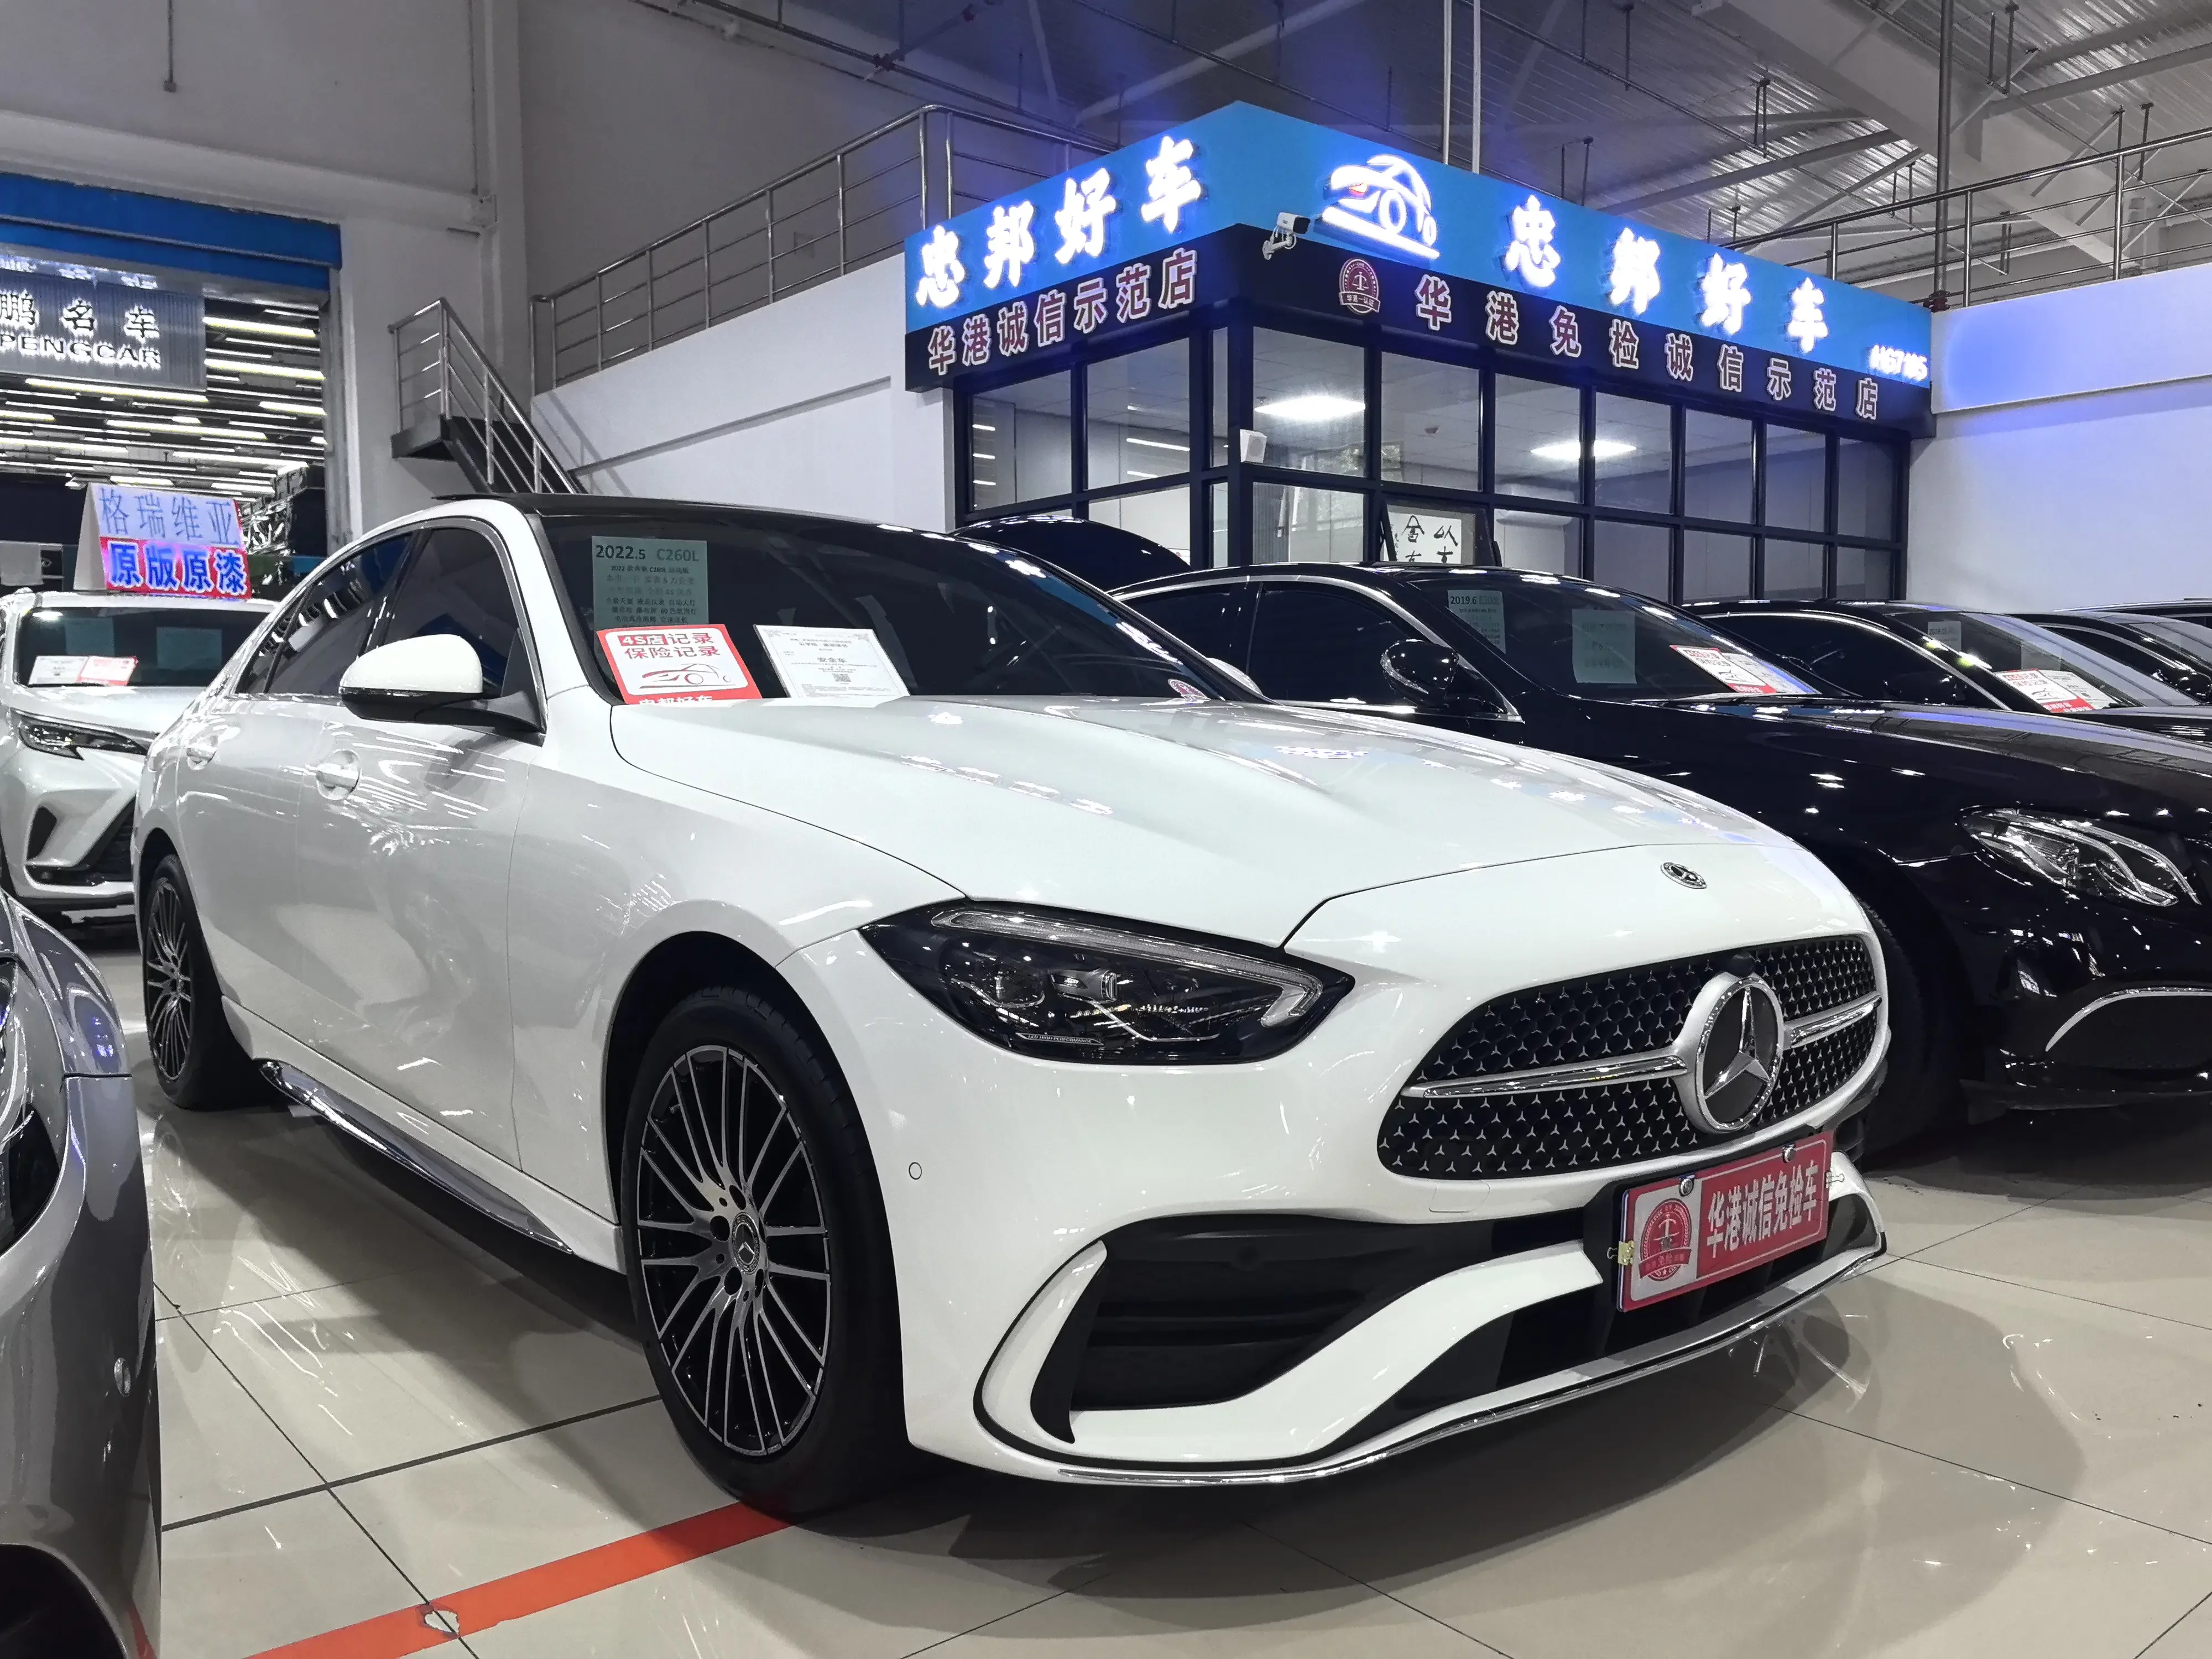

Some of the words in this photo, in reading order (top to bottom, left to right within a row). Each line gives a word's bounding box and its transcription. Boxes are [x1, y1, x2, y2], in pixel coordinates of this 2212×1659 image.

[916, 135, 1202, 307] 忠邦好车
[1505, 195, 1828, 354] 忠邦好车
[928, 248, 1197, 375] 华港诚信示范店
[1415, 274, 1879, 420] 华港免检诚信示范店
[100, 487, 242, 549] 格瑞维亚
[108, 541, 247, 593] 原版原漆
[595, 544, 646, 560] 2022.5
[656, 548, 700, 562] C260L
[1451, 596, 1477, 604] 2019.6
[621, 633, 714, 646] 4S店记录
[625, 646, 721, 659] 保险记录
[1707, 1160, 1819, 1259] 华港诚信免检车
